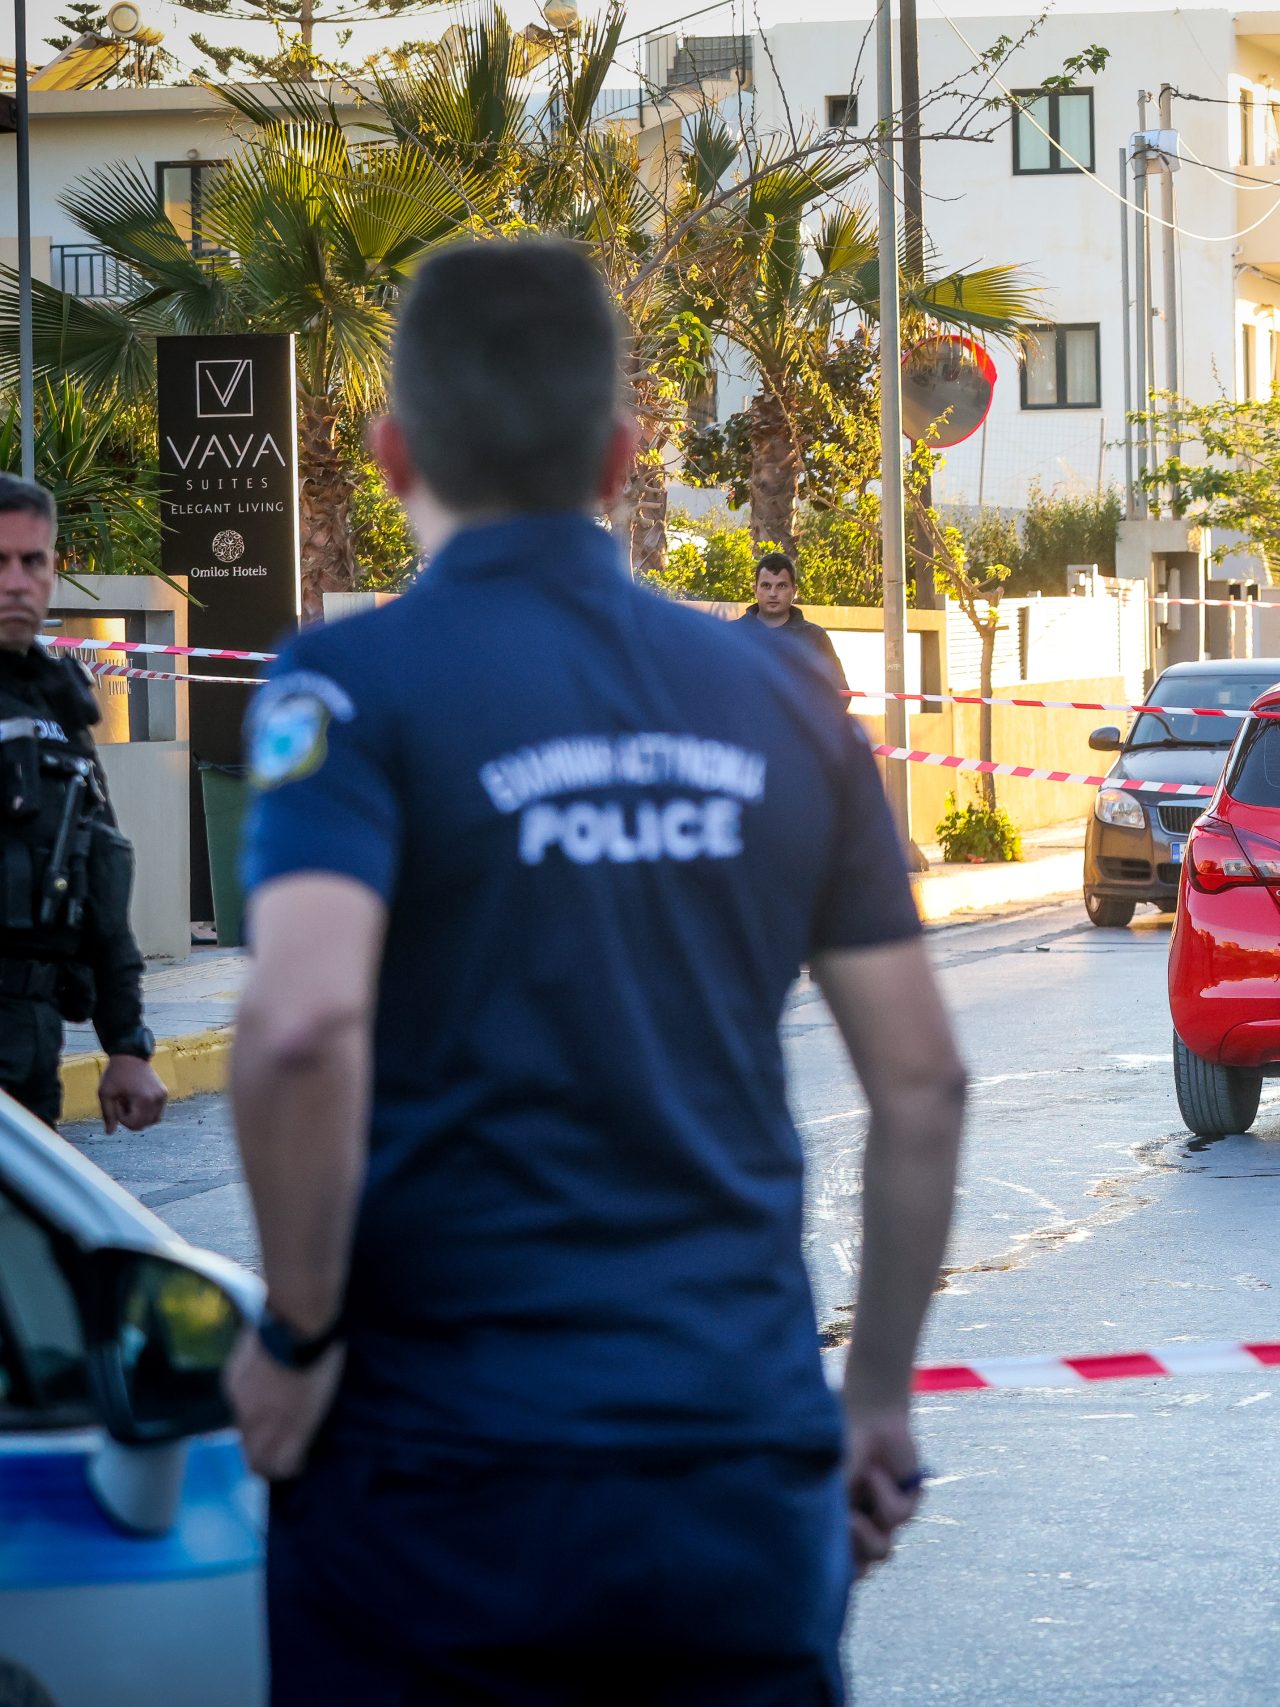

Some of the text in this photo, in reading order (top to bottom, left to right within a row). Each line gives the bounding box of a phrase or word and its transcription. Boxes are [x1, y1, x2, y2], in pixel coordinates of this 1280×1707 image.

[166, 433, 286, 470] VAYA
[186, 478, 268, 490] SUITES
[171, 501, 284, 514] ELEGANT LIVING
[190, 565, 268, 578] Omilos Hotels
[517, 798, 744, 866] POLICE
